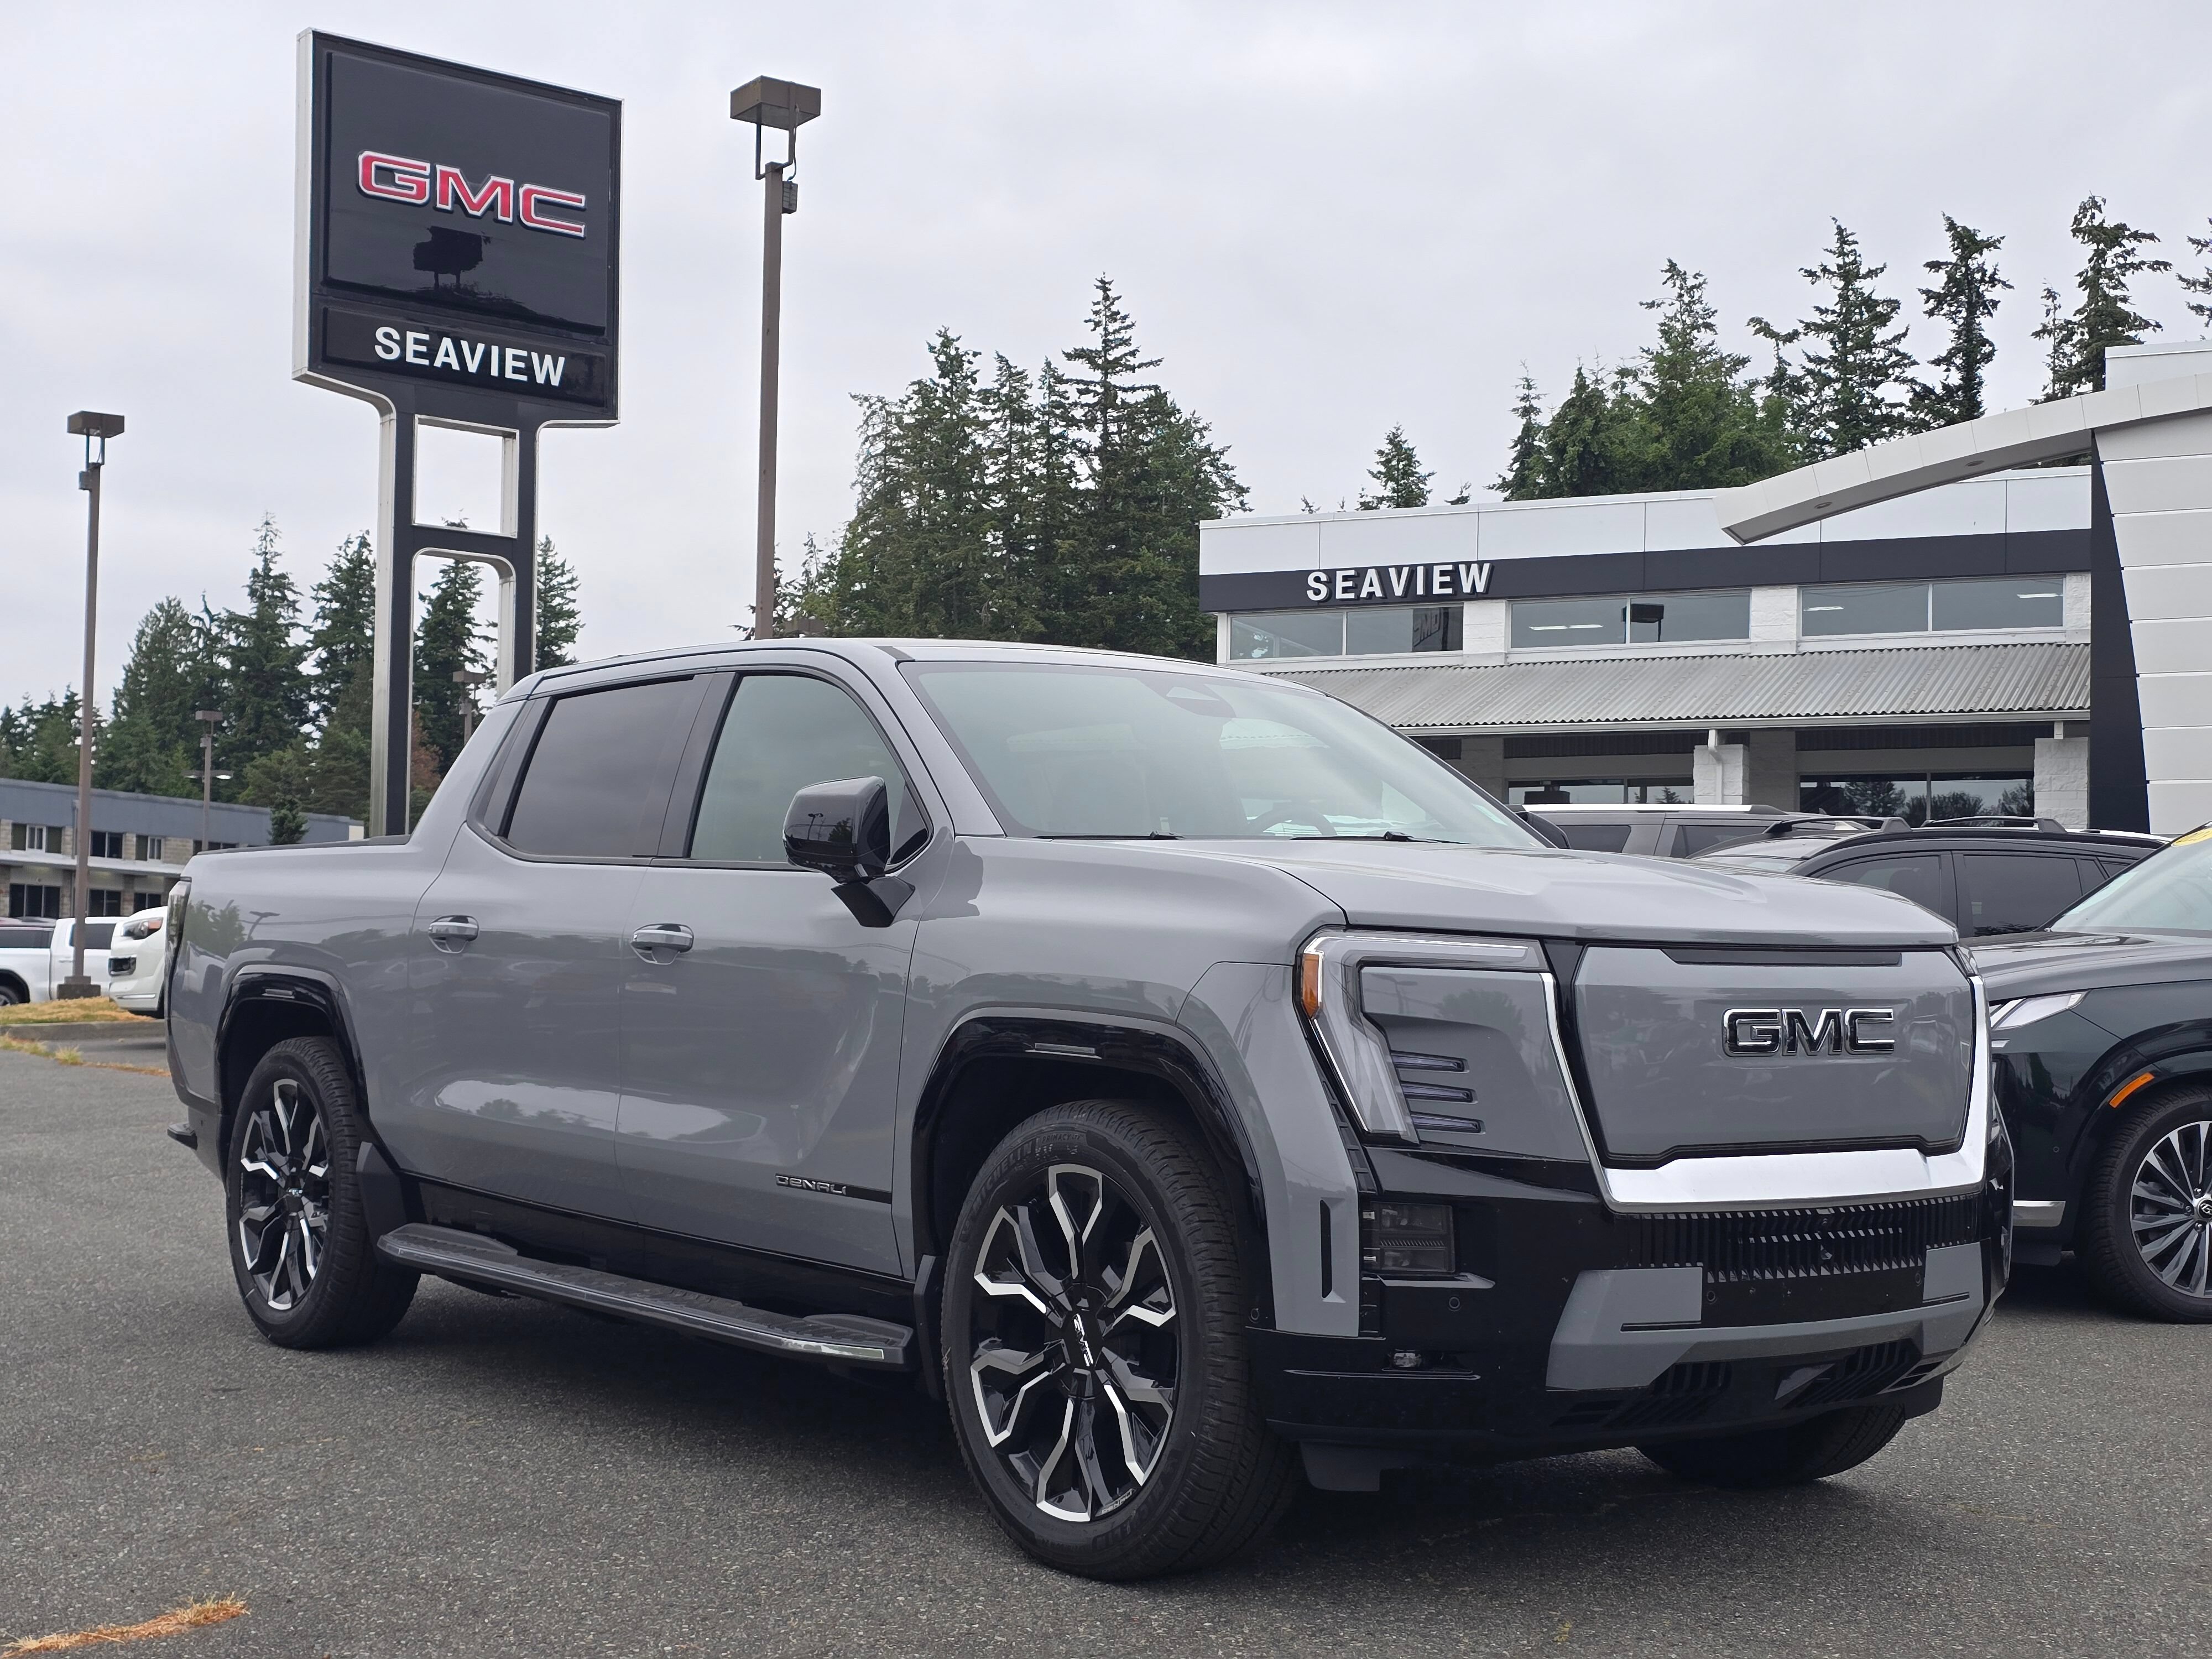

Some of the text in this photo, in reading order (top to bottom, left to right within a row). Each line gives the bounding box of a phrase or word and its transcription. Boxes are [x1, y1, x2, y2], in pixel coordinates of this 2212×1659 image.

[357, 150, 586, 238] GMC
[374, 326, 565, 387] SEAVIEW
[1306, 562, 1493, 602] SEAVIEW
[1722, 1008, 1895, 1056] GMC
[775, 1175, 847, 1195] DENALI
